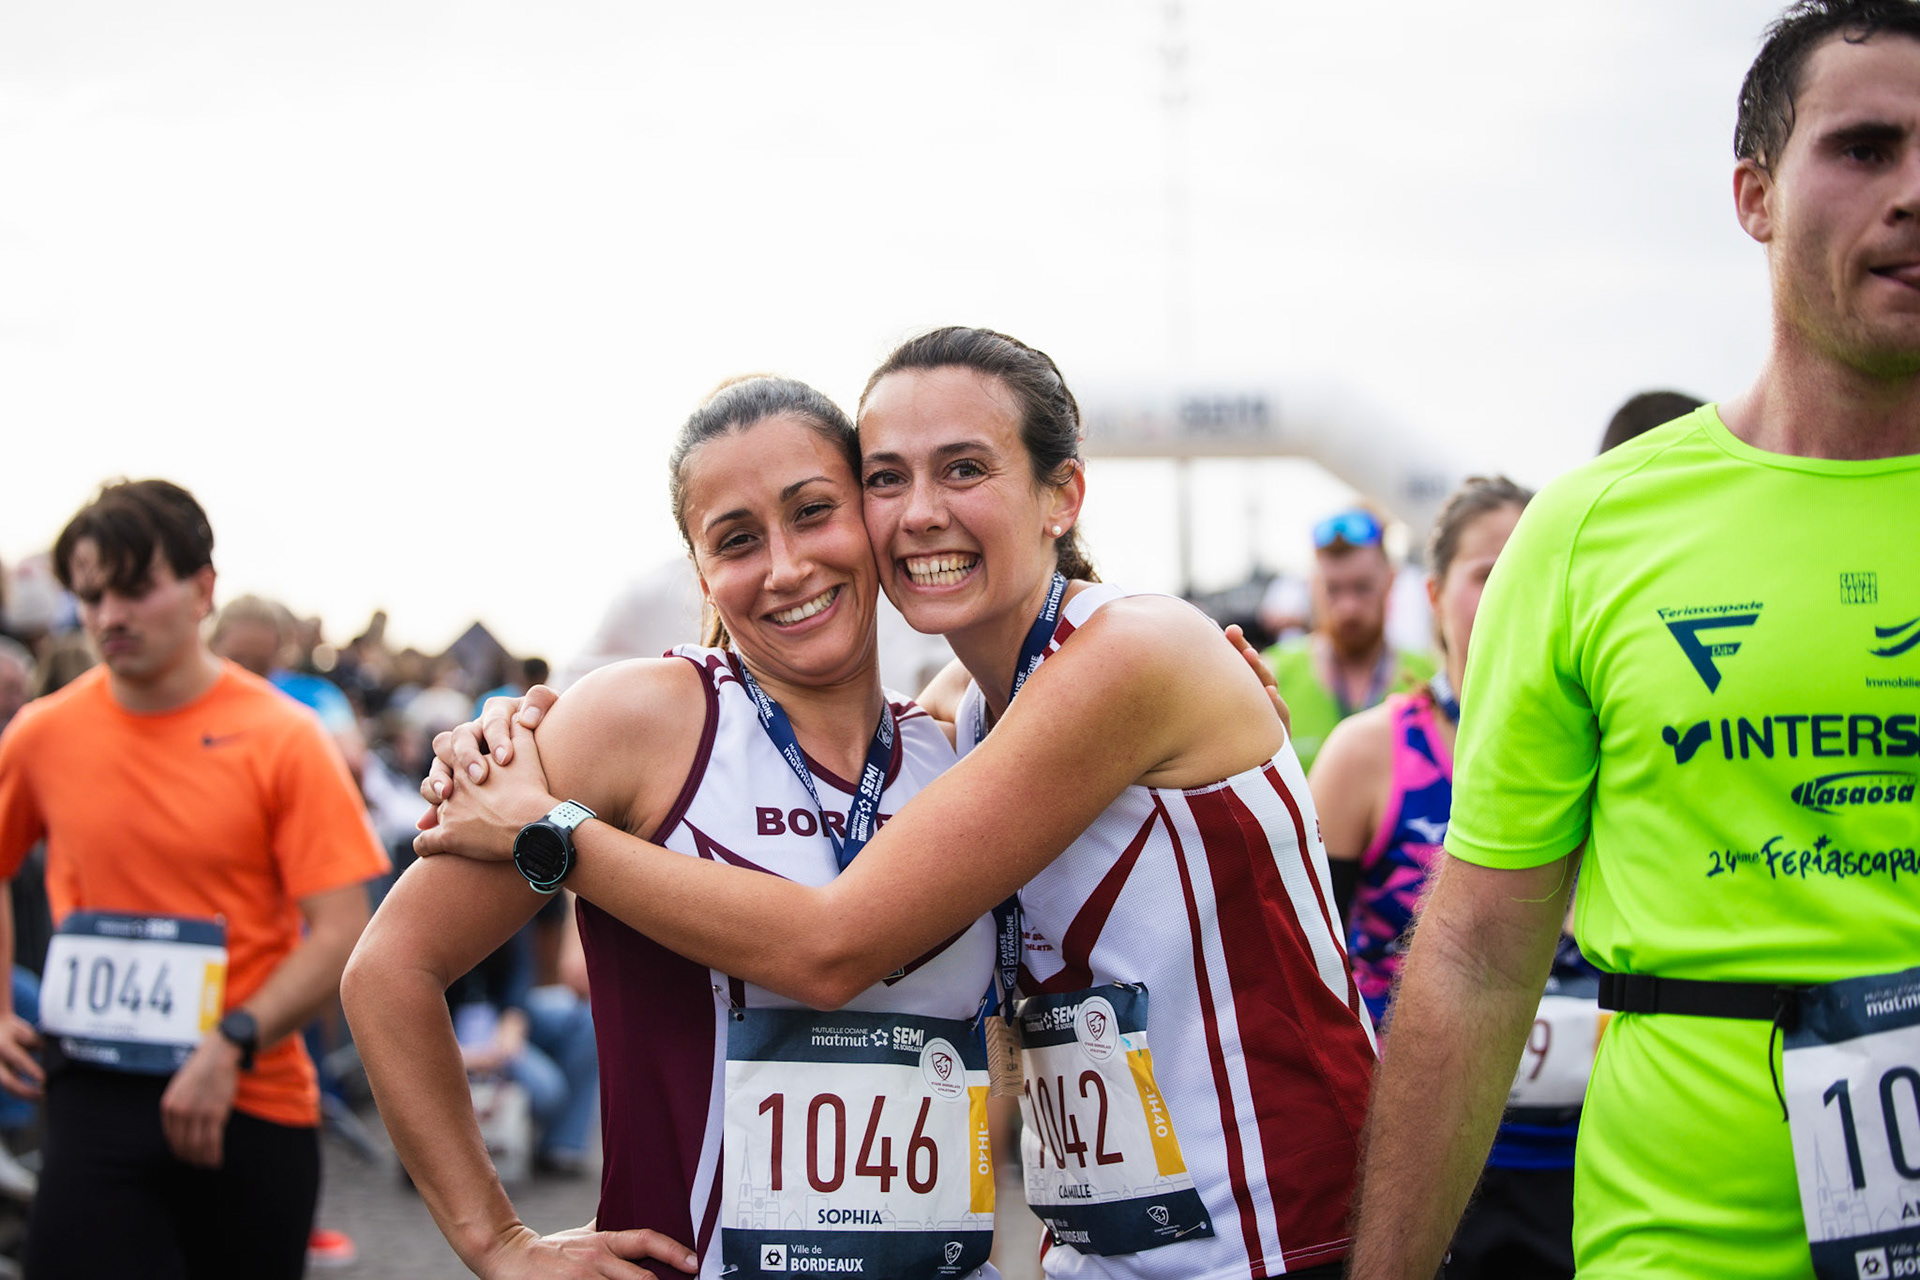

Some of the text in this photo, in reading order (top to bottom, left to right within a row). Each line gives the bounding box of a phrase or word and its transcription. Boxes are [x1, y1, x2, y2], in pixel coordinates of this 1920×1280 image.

[1045, 582, 1063, 621] matmut
[1657, 600, 1763, 620] Feriascapade
[1720, 714, 1920, 761] INTERS
[784, 747, 814, 793] matmut
[860, 763, 880, 798] SEMI
[1801, 782, 1915, 807] Lasaosa
[756, 806, 893, 838] BOR
[1000, 933, 1008, 966] CAISSE
[65, 954, 174, 1016] 1044
[1052, 1004, 1080, 1024] SEM
[811, 1033, 869, 1048] matmut
[844, 1027, 868, 1035] OCIANE
[893, 1026, 925, 1046] SEMI
[1528, 1018, 1552, 1081] 9
[1024, 1070, 1124, 1169] 1042
[1145, 1086, 1168, 1138] -1H40
[1822, 1066, 1920, 1191] 10
[758, 1093, 938, 1194] 1046
[978, 1122, 989, 1176] -1H40
[1059, 1184, 1092, 1199] CAMILLE
[817, 1209, 883, 1225] SOPHIA
[790, 1257, 864, 1272] BORDEAUX
[791, 1245, 822, 1254] Ville de
